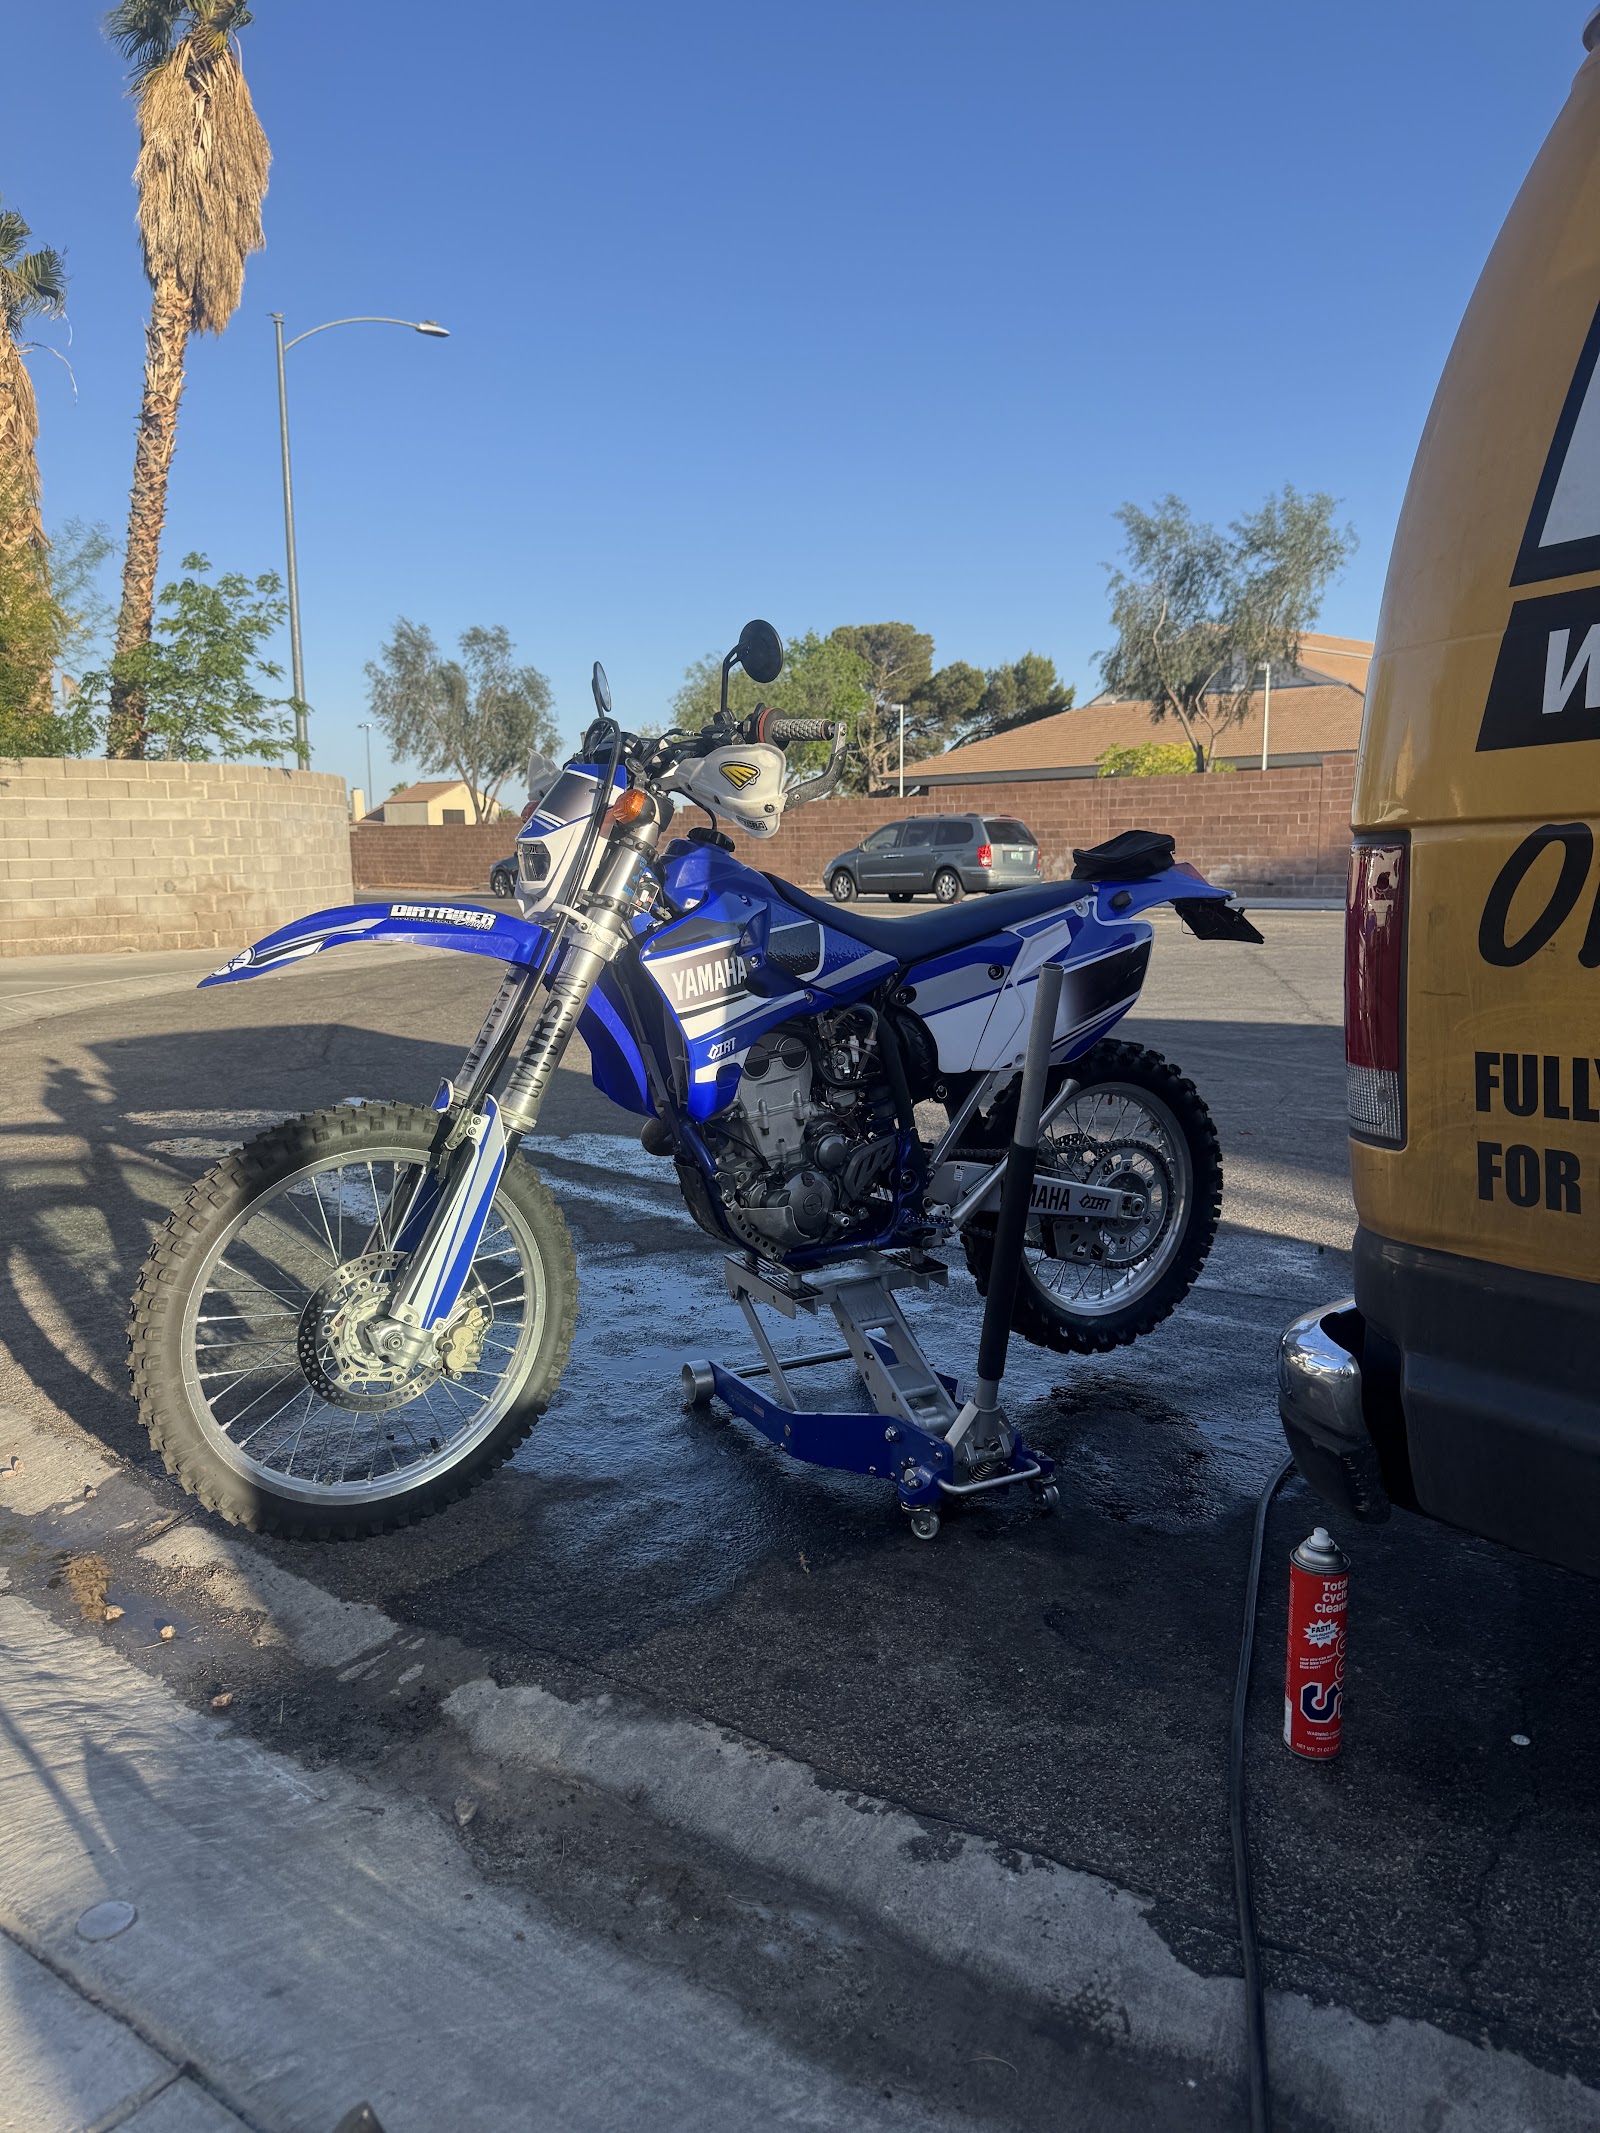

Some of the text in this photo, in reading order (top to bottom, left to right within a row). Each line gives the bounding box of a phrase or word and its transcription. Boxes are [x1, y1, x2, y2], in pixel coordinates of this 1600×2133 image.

[1478, 822, 1600, 968] O
[671, 956, 748, 1001] YAMAHA
[1475, 1052, 1600, 1122] FULL
[1477, 1141, 1581, 1214] FOR
[1079, 1193, 1112, 1211] DIRT
[1322, 1577, 1348, 1591] Total
[1322, 1590, 1348, 1603] Cycle
[1314, 1600, 1348, 1613] Cleane
[1311, 1624, 1331, 1633] FAST!
